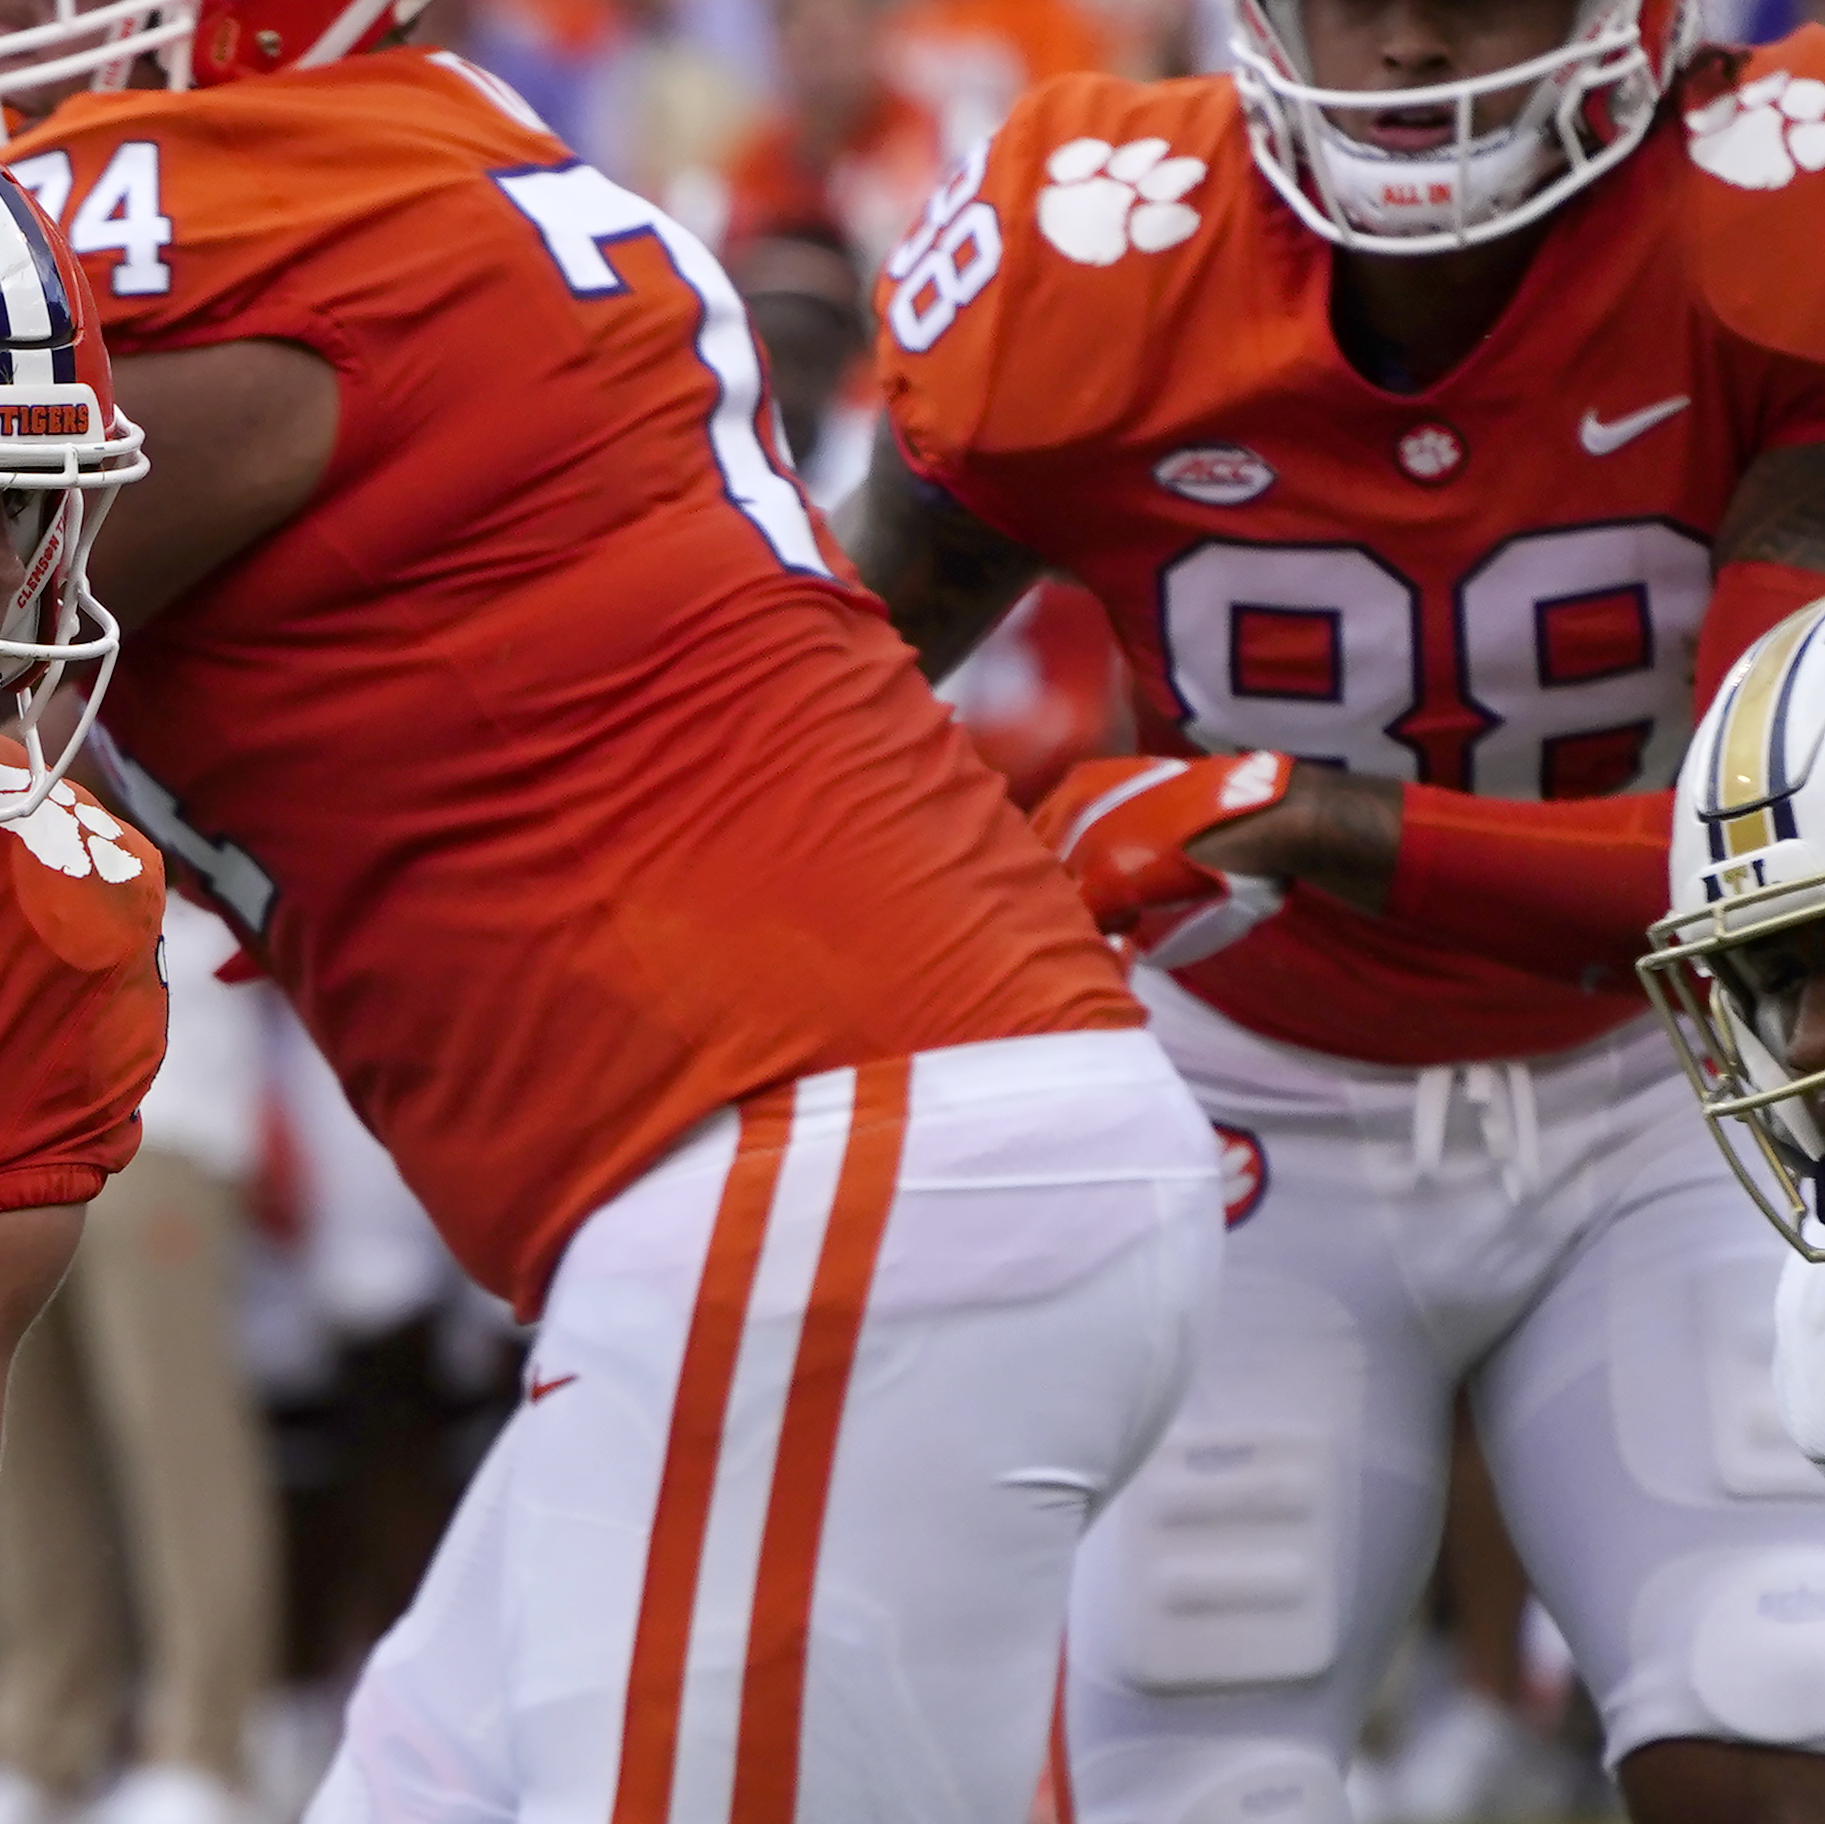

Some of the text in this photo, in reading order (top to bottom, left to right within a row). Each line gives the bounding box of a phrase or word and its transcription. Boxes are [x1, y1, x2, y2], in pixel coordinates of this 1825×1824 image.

[6, 140, 173, 294] 74
[888, 137, 1003, 352] 88
[16, 535, 60, 609] CLEMSON
[1157, 513, 1715, 803] 88
